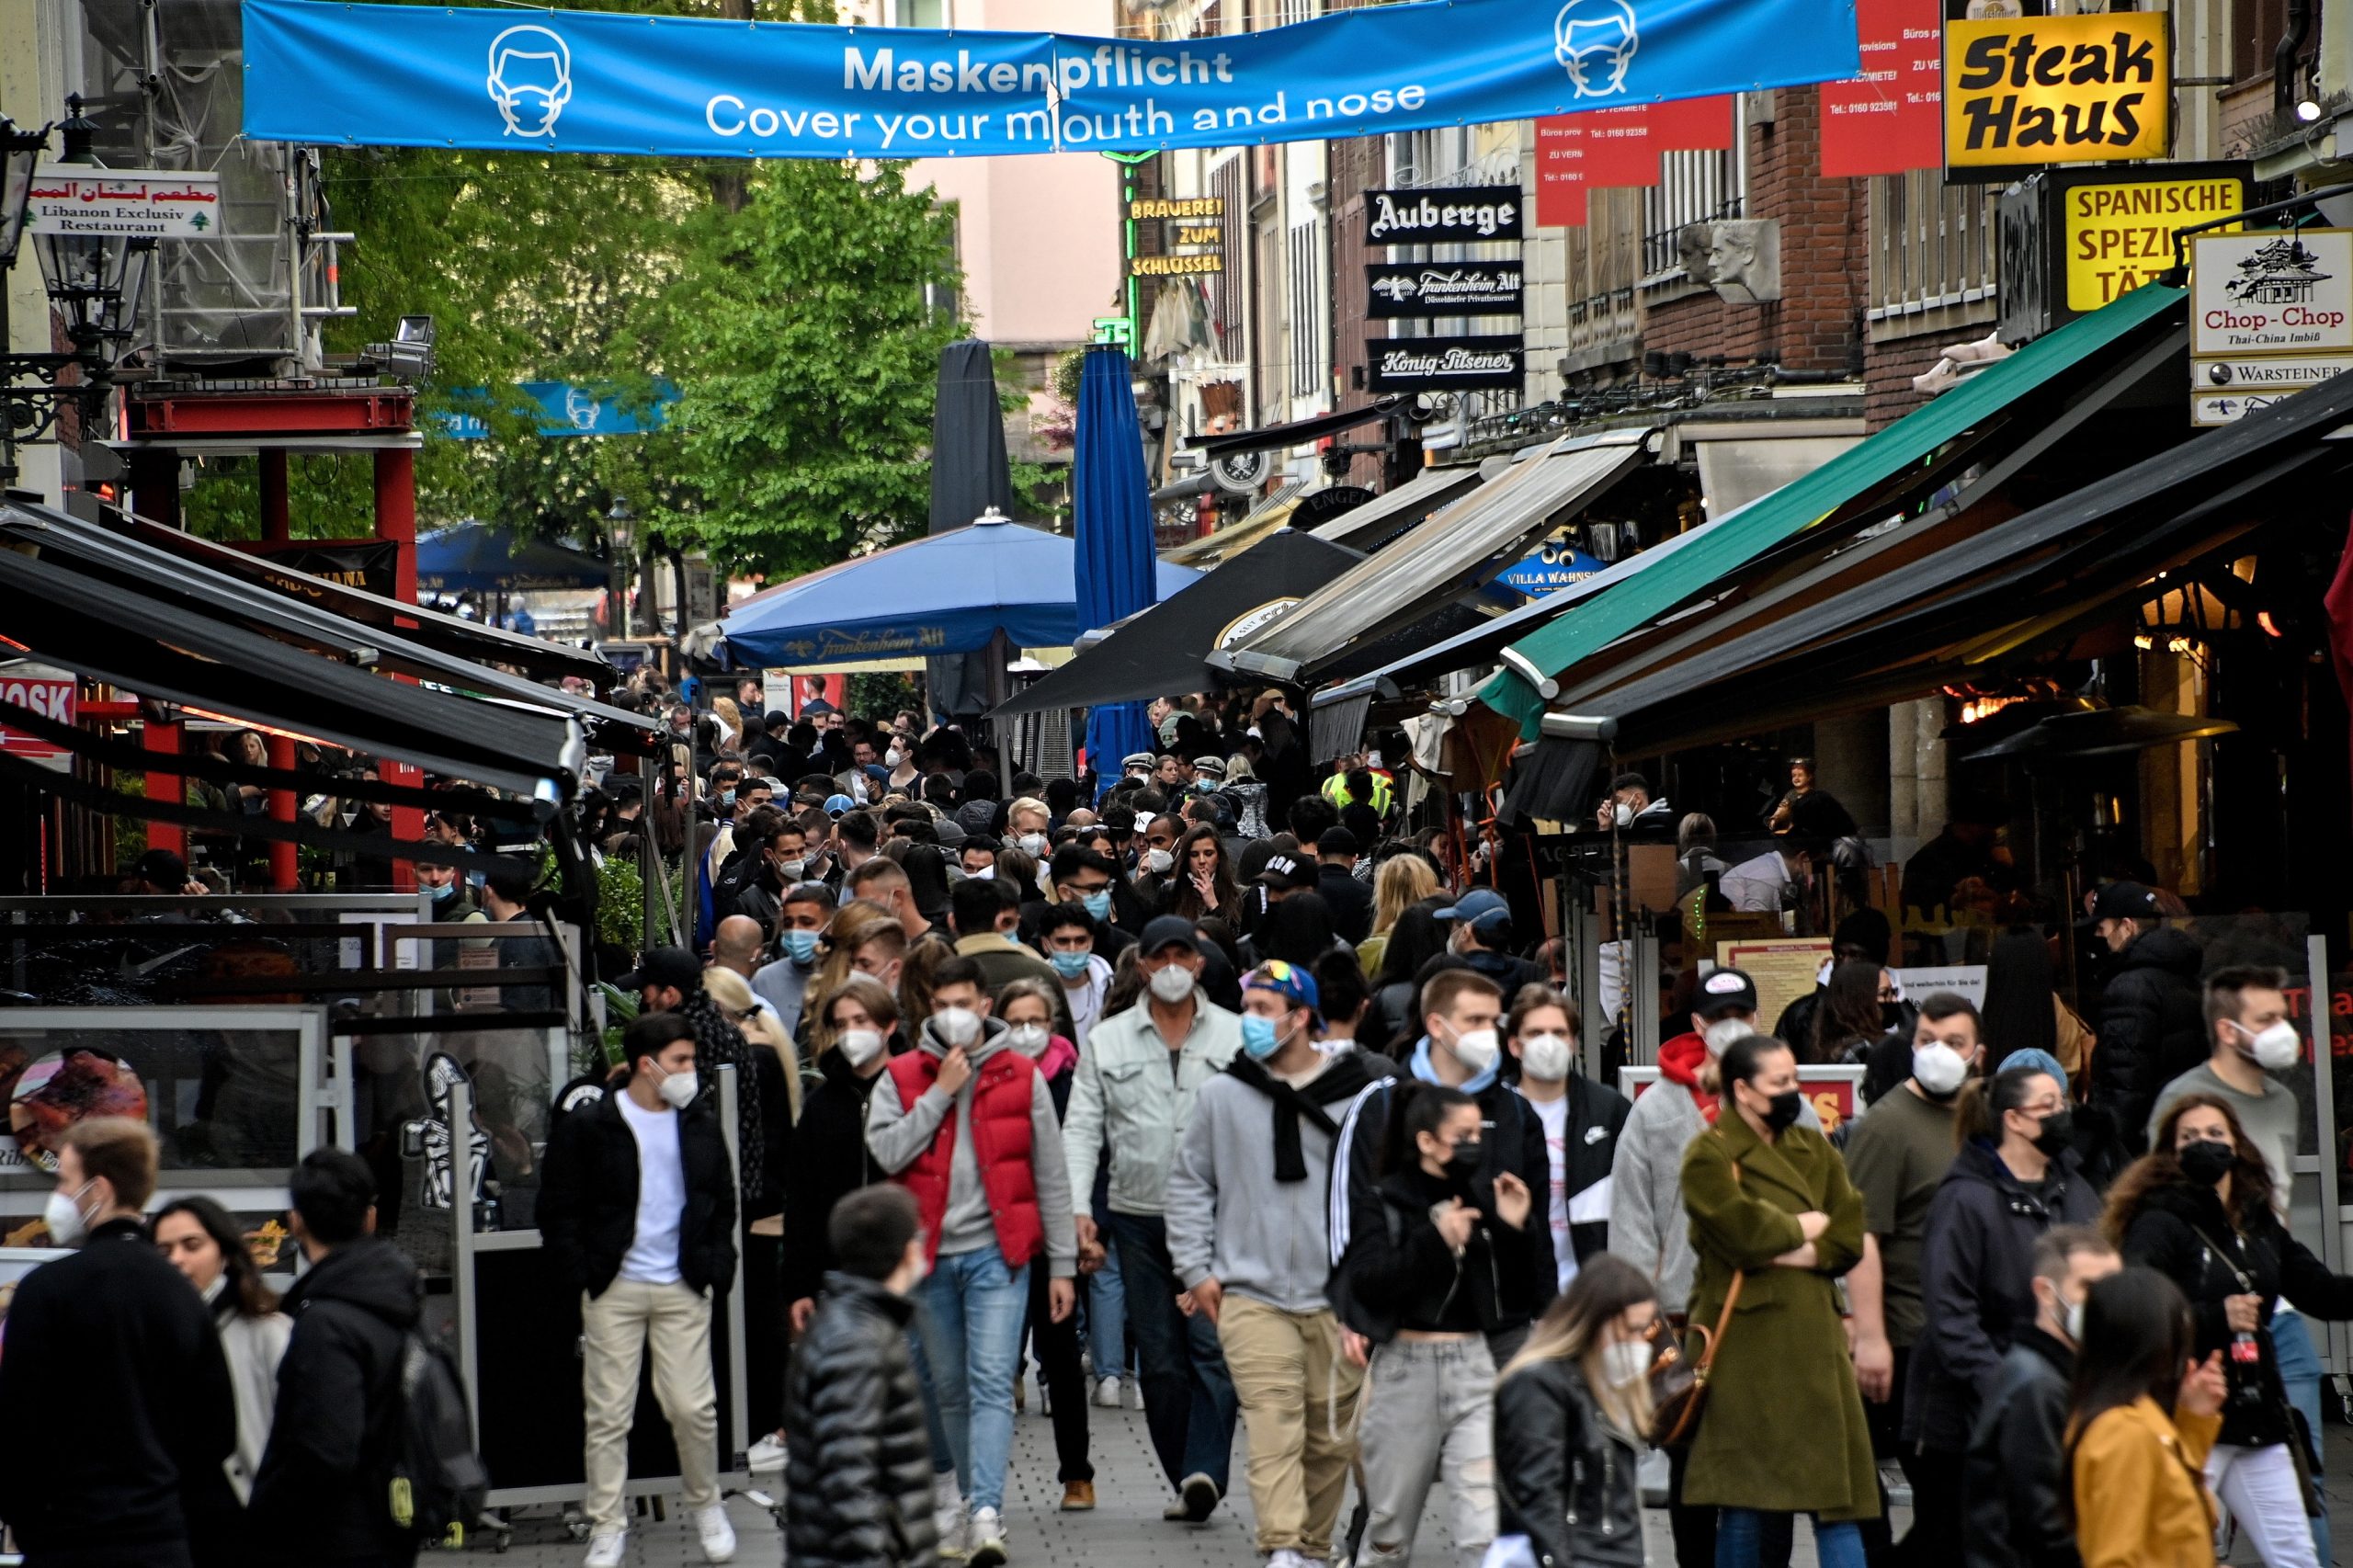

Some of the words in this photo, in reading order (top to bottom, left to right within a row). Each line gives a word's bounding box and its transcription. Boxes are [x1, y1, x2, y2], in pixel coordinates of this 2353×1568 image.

[1903, 28, 1929, 40] Büros
[1859, 41, 1896, 52] rovisions
[1912, 61, 1925, 71] ZU
[1959, 31, 2154, 90] Steak
[843, 45, 1233, 100] Maskenpflicht
[705, 95, 860, 138] Cover
[873, 112, 990, 149] your
[1006, 98, 1174, 144] mouth
[1192, 91, 1287, 131] and
[1306, 85, 1426, 120] nose
[1848, 103, 1868, 113] 0160
[1962, 93, 2145, 150] Haus
[1540, 129, 1563, 137] Büros
[81, 183, 147, 203] لبنان
[151, 185, 217, 204] مطعم
[2077, 184, 2233, 217] SPANISCHE
[42, 206, 110, 218] Libanon
[117, 208, 184, 220] Exclusiv
[1131, 199, 1223, 219] BRAUEREI
[1370, 194, 1516, 238] Auberge
[61, 220, 165, 233] Restaurant
[1179, 227, 1221, 244] ZUM
[1131, 255, 1222, 276] SCHLÜSSEL
[1417, 268, 1495, 297] Frankenheim
[1496, 271, 1521, 292] Alt
[1425, 295, 1466, 304] Düsseldorfer
[1468, 293, 1515, 303] Privatbrauerei
[2228, 333, 2286, 345] Thai-China
[2290, 332, 2321, 342] Imbiß
[1381, 348, 1514, 376] König-Pilsener
[2237, 366, 2342, 381] WARSTEINER
[1507, 573, 1544, 585] VILLA
[1548, 572, 1596, 584] WAHNS
[819, 629, 915, 660] Frankenheim
[917, 627, 944, 647] Alt
